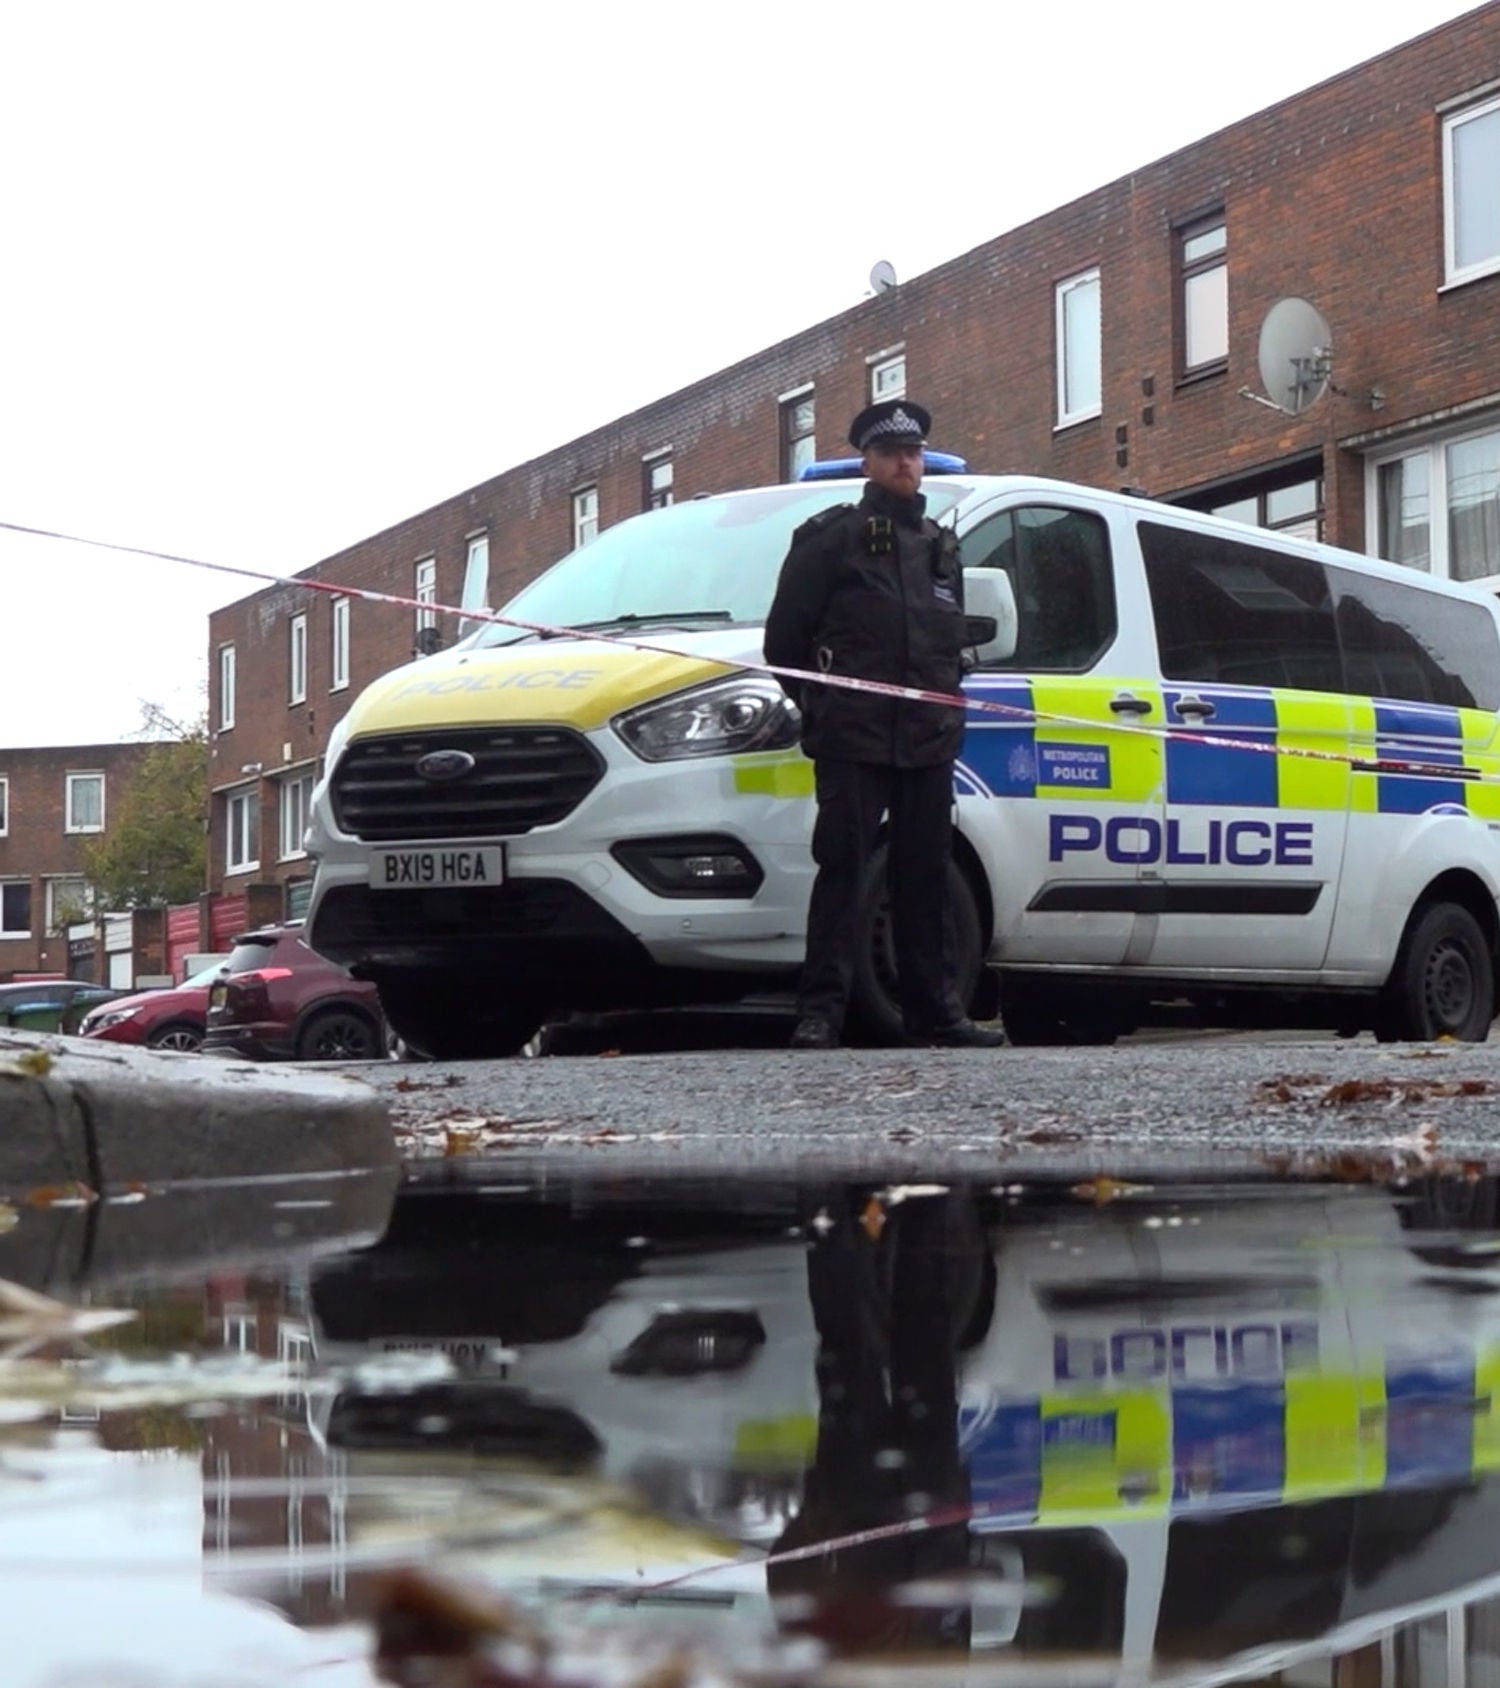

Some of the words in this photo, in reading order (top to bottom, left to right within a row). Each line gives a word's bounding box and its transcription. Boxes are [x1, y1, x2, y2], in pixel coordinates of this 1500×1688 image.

[392, 669, 603, 702] POLICE
[1042, 749, 1106, 763] METROPOLITAN
[1052, 766, 1099, 780] POLICE
[1049, 814, 1314, 867] POLICE
[384, 854, 434, 882] BX19
[442, 852, 486, 881] HGA
